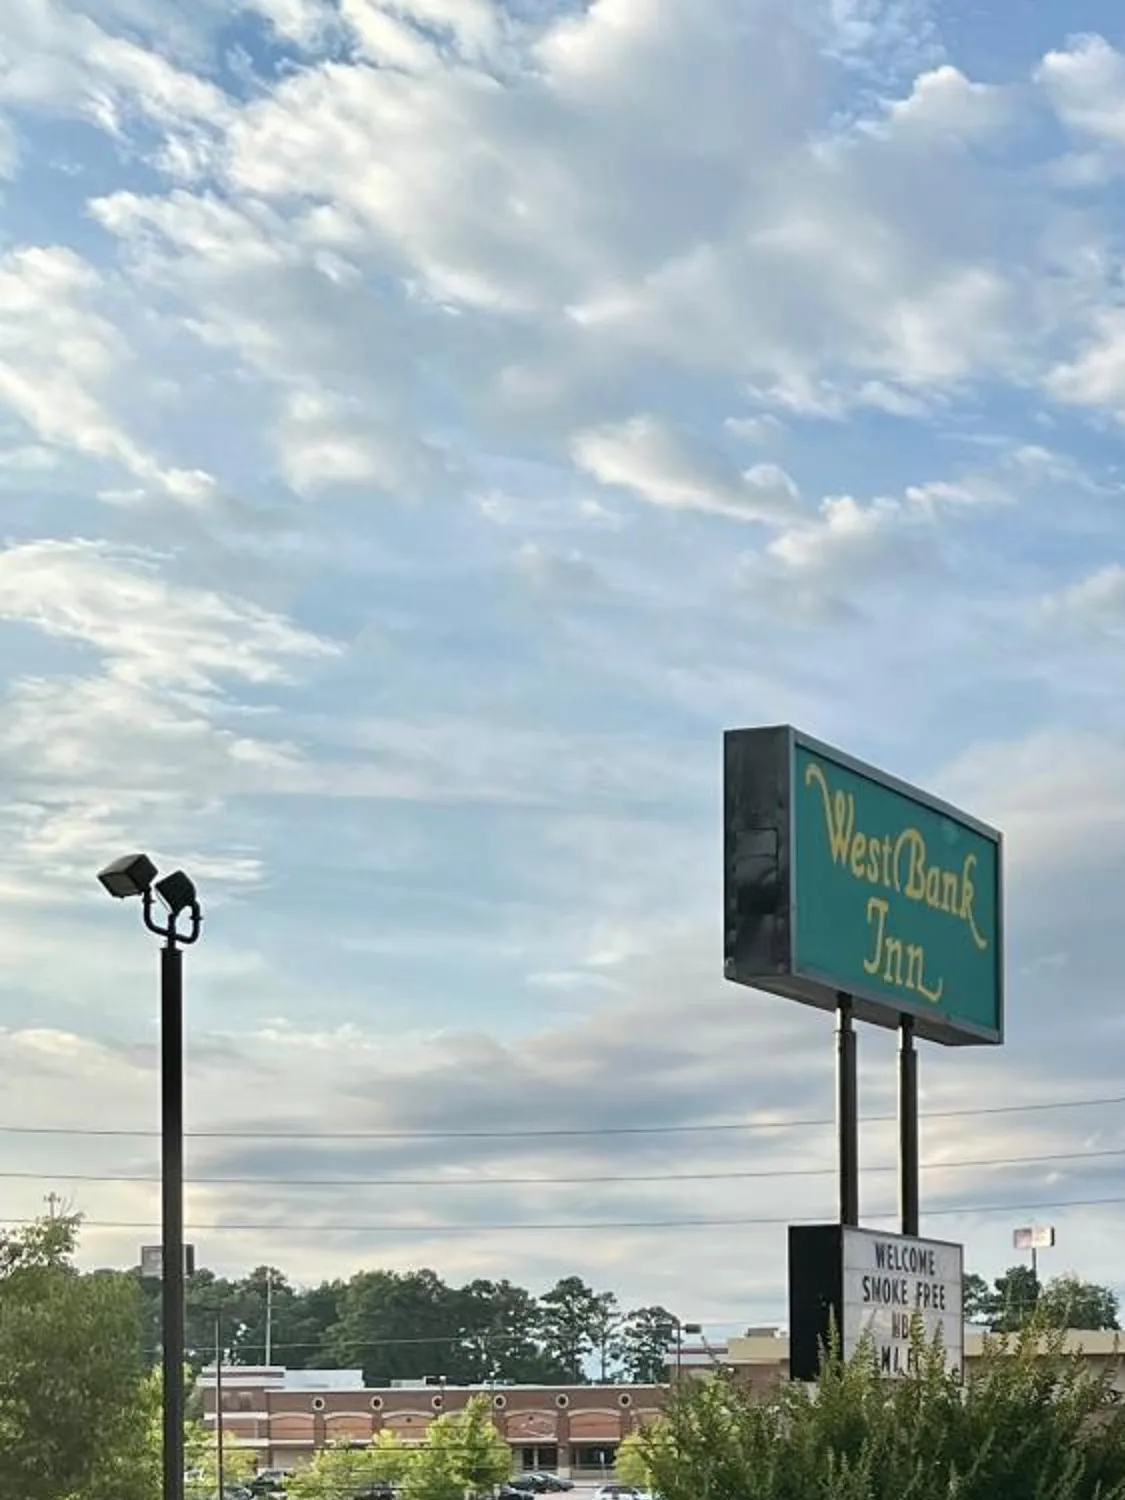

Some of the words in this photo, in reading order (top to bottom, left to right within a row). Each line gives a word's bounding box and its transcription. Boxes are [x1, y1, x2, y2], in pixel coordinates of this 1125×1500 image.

[805, 763, 891, 887] West
[893, 827, 987, 949] Bank
[863, 897, 943, 1002] Inn
[862, 1275, 909, 1305] SMOKE
[916, 1281, 946, 1310] FREE
[875, 1242, 935, 1276] WELCOME
